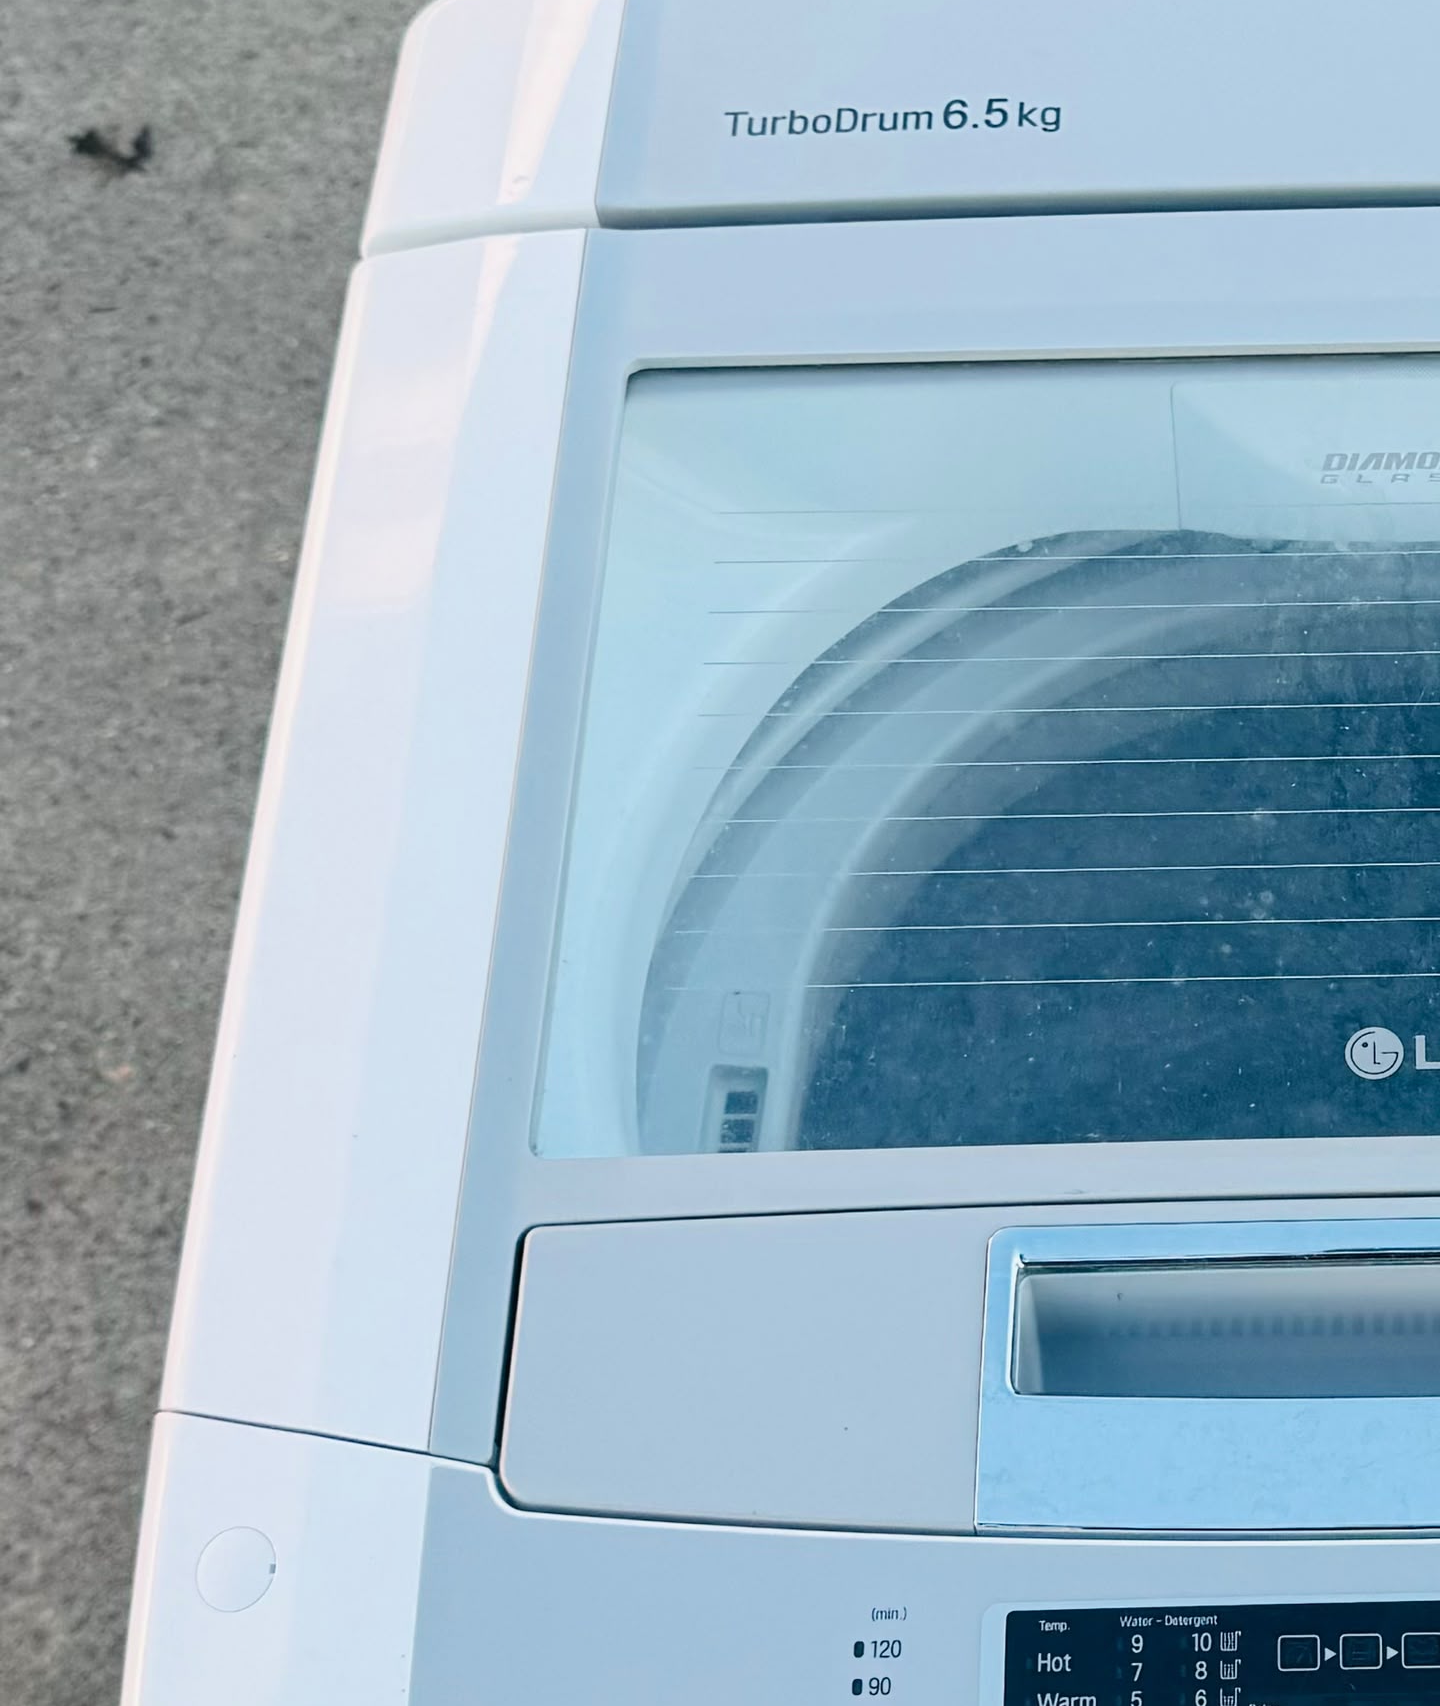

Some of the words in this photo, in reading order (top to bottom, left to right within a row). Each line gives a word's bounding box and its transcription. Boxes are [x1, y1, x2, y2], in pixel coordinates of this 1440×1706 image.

[724, 107, 933, 137] TurboDrum
[1038, 1619, 1071, 1633] Temp.
[1119, 1615, 1154, 1628] Water
[1164, 1614, 1218, 1628] Detergent
[871, 1639, 902, 1659] 120
[1131, 1634, 1144, 1654] 9
[1191, 1632, 1212, 1652] 10
[1037, 1652, 1072, 1673] Hot
[1131, 1662, 1143, 1682] 7
[1194, 1660, 1208, 1680] 8
[868, 1676, 892, 1696] 90
